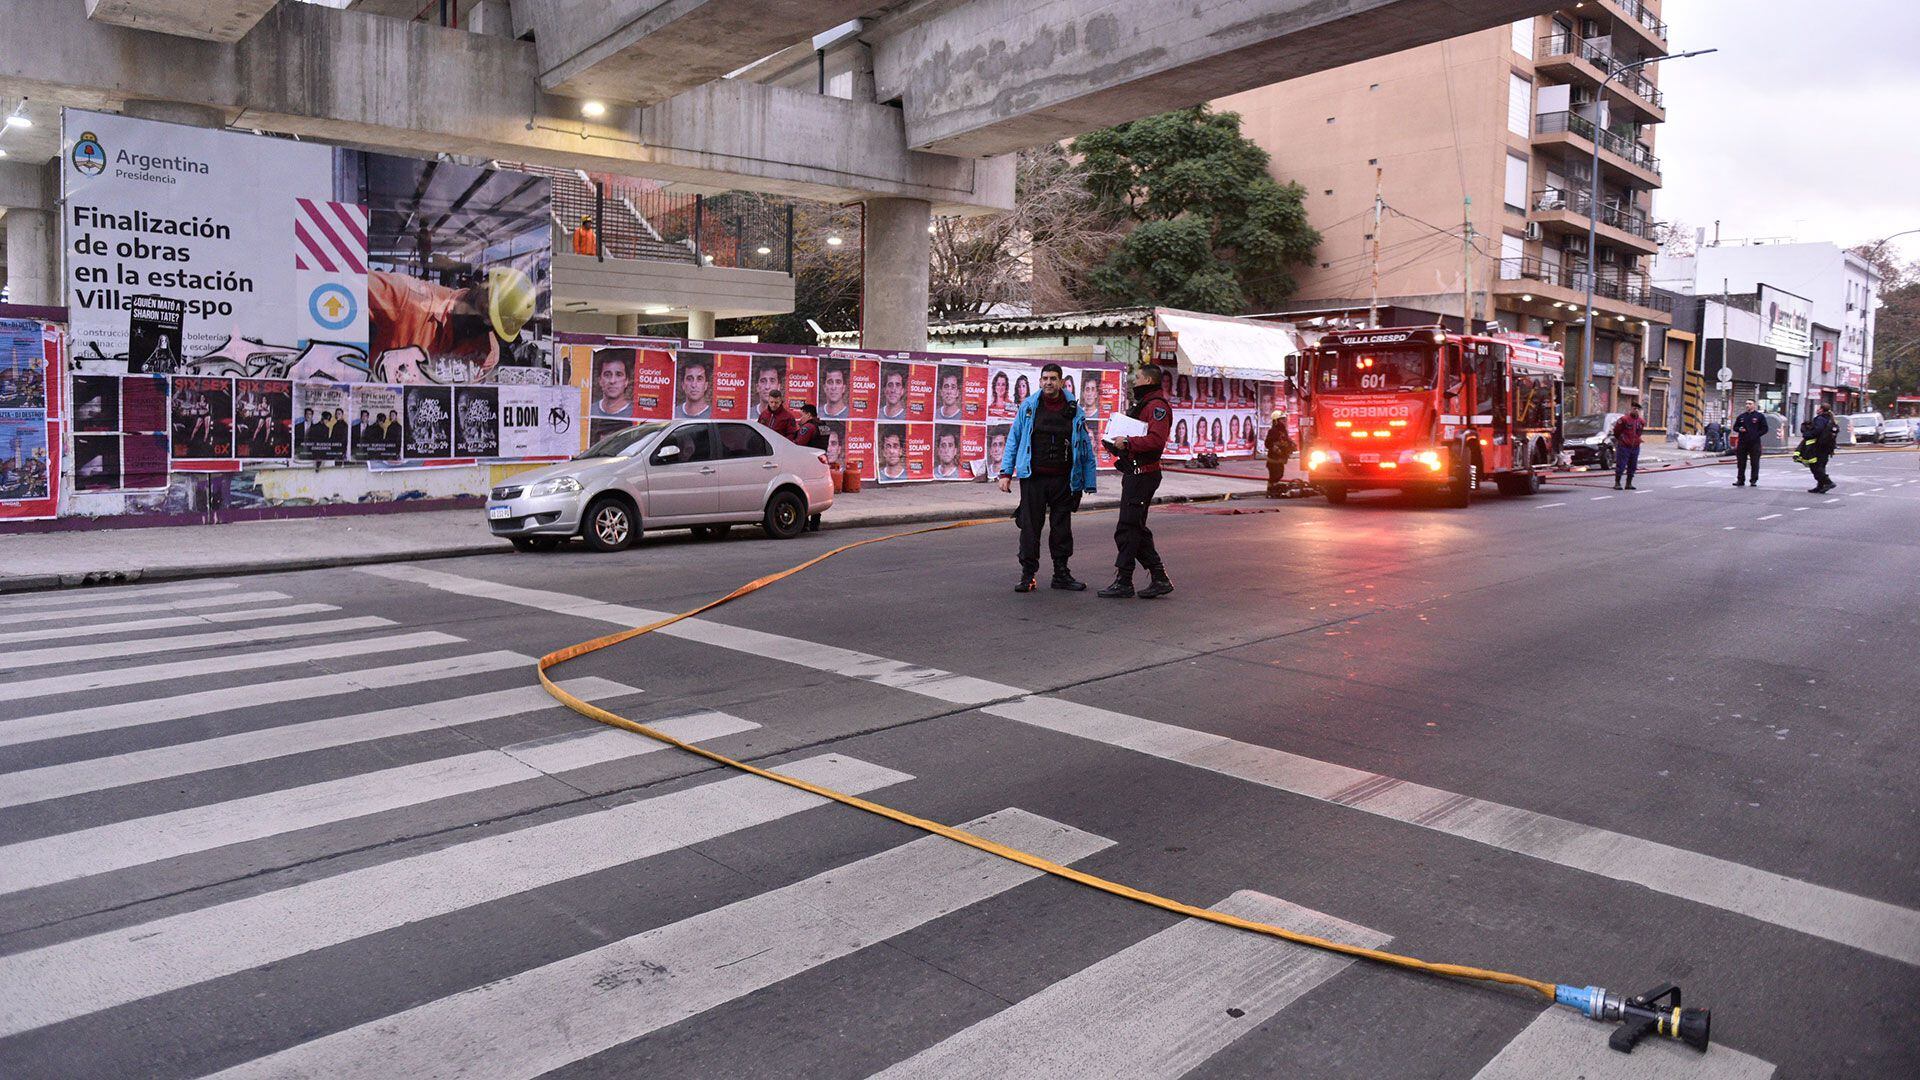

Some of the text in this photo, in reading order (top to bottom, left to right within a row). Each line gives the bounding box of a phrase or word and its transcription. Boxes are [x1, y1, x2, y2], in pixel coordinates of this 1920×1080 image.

[116, 149, 209, 174] Argentina
[116, 169, 176, 184] Presidencia
[74, 206, 231, 240] Finalización
[74, 233, 191, 262] de obras
[75, 263, 253, 292] en la estación
[133, 297, 181, 311] ¿QUIÉN MATÓ A
[133, 308, 180, 322] SHARON TATE?
[1370, 334, 1407, 343] CRESPO
[1478, 345, 1489, 355] 601
[639, 368, 662, 376] Gabriel
[175, 379, 229, 391] SIX SEX
[639, 376, 671, 385] SOLANO
[717, 378, 745, 387] SOLANO
[789, 380, 814, 388] SOLANO
[853, 382, 876, 390] SOLANO
[1361, 374, 1385, 388] 601
[238, 381, 290, 393] SIX SEX
[910, 385, 932, 393] SOLANO
[503, 406, 514, 427] EL
[516, 406, 538, 427] DON
